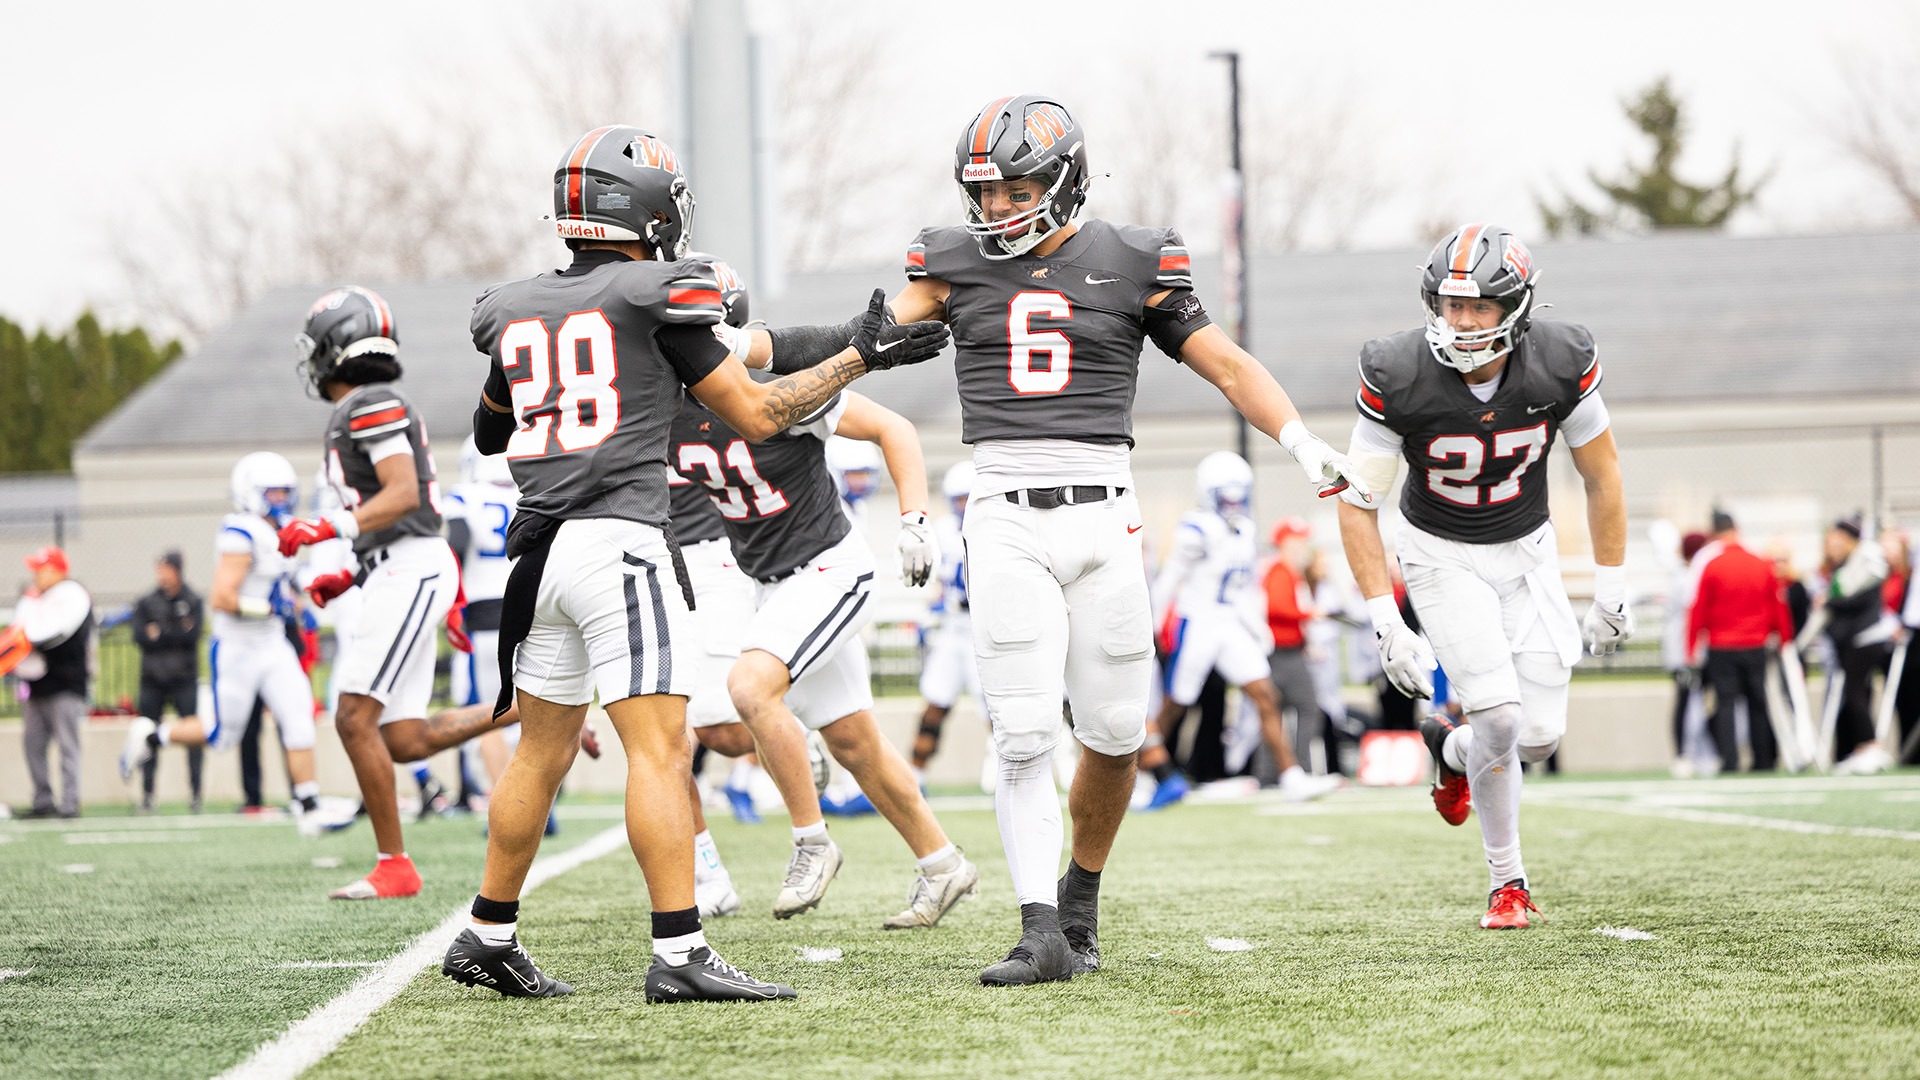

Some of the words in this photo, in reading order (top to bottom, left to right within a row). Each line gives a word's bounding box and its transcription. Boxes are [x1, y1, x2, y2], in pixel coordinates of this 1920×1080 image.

[964, 167, 995, 178] Riddell
[557, 222, 606, 239] Riddell
[1442, 283, 1475, 293] Riddell
[1006, 289, 1074, 396] 6
[500, 307, 621, 461] 28
[677, 437, 790, 520] 31
[1427, 420, 1548, 507] 27
[657, 981, 679, 995] VAPOR
